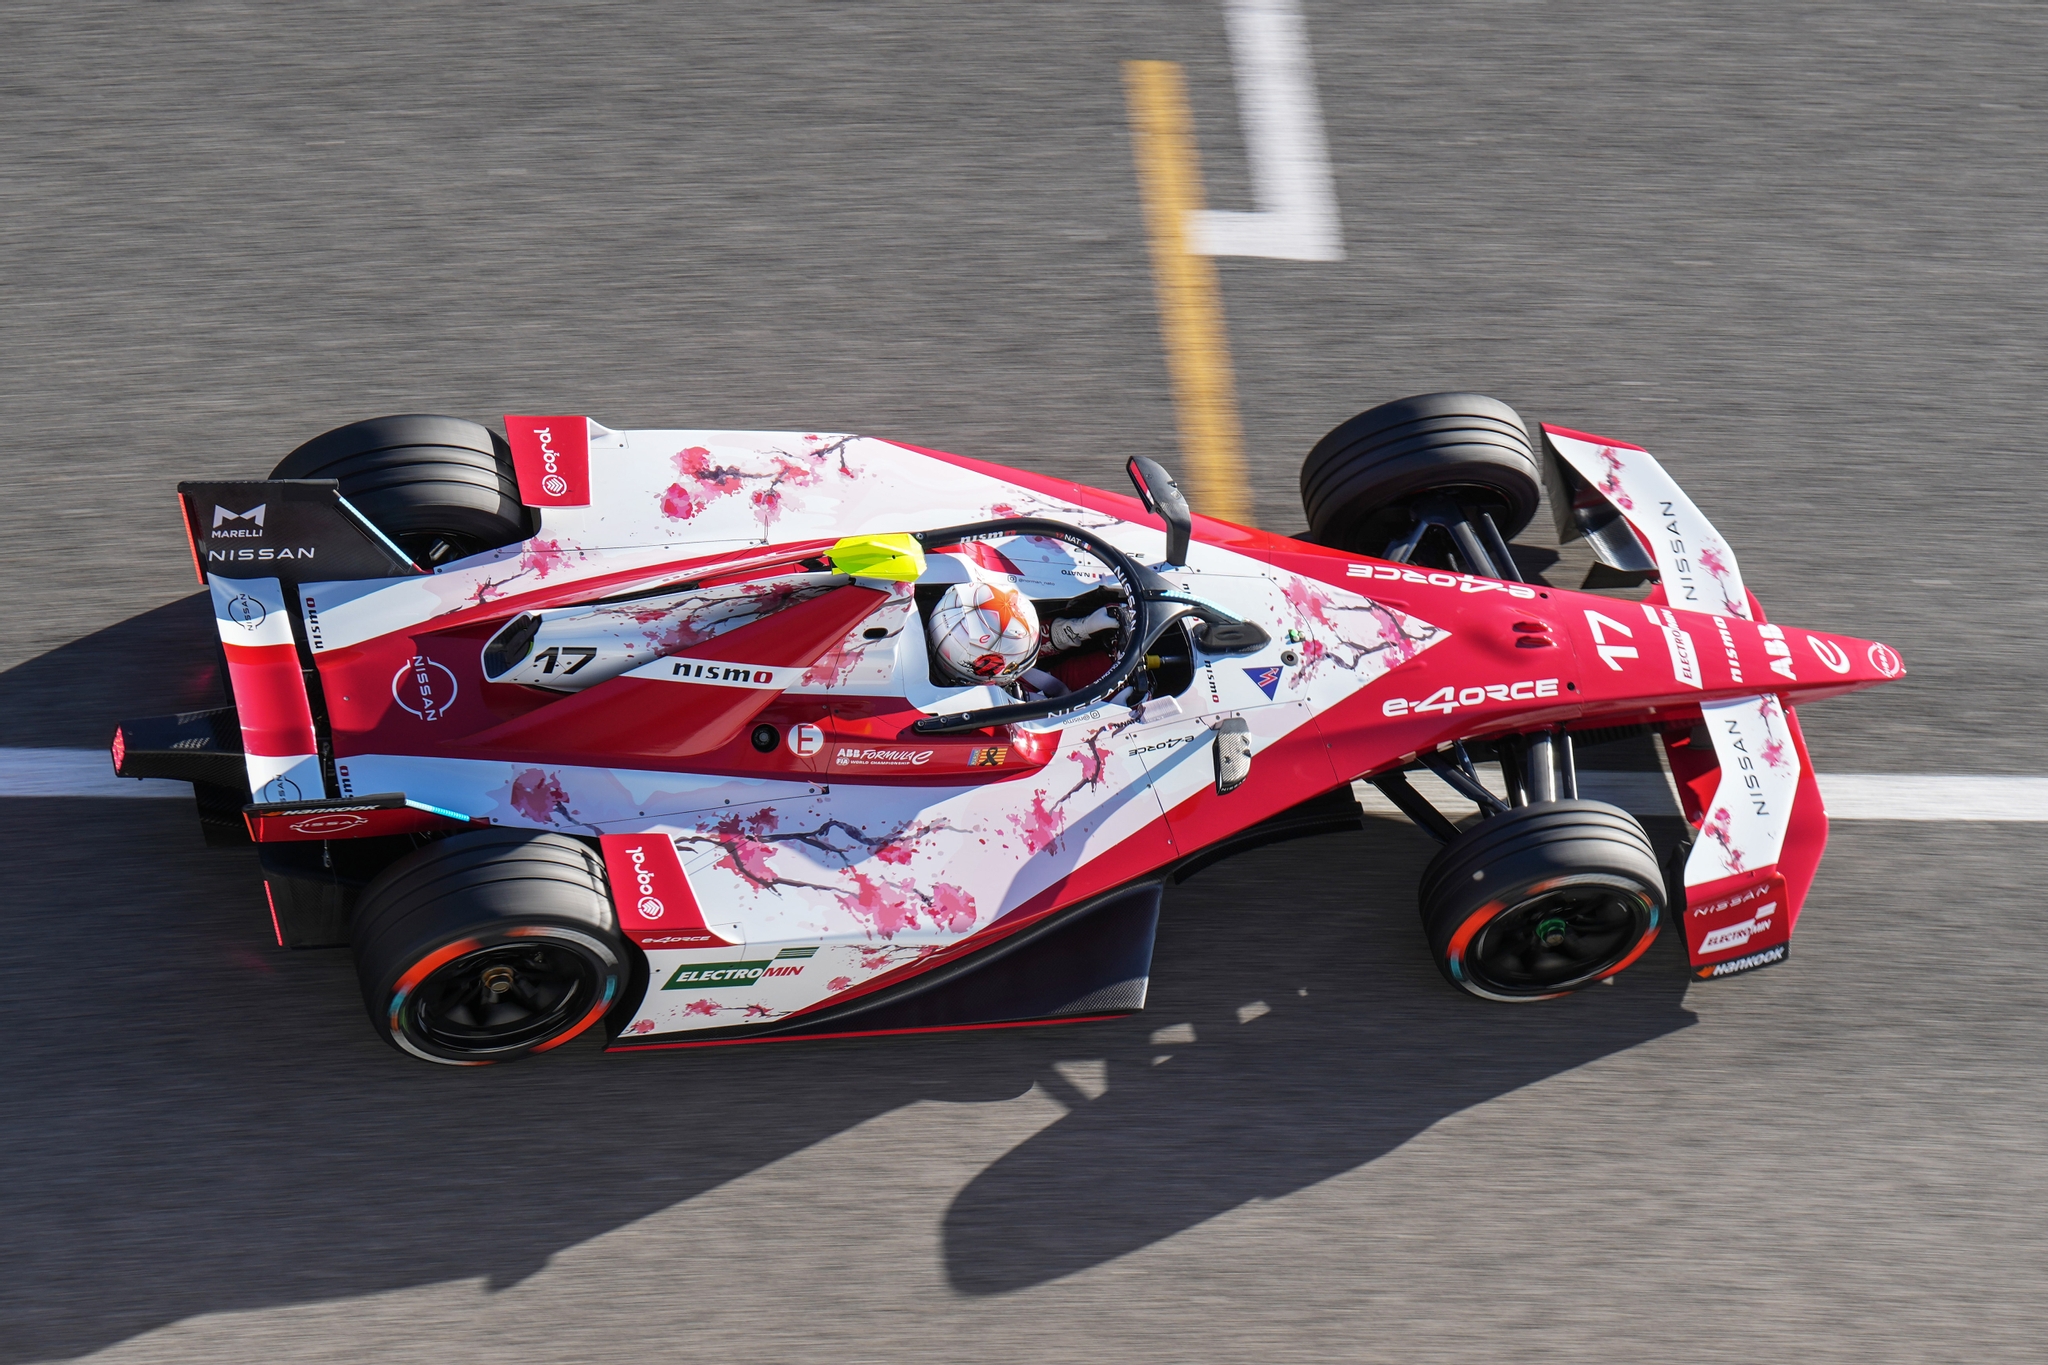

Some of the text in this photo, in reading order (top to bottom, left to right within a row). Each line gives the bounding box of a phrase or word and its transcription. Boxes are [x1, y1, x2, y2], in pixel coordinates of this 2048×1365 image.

[211, 529, 263, 538] MARELLI
[1064, 533, 1082, 545] NAT
[208, 547, 315, 562] NISSAN
[1659, 501, 1698, 601] NISSAN
[240, 593, 254, 631] NISSAN
[1113, 565, 1137, 632] NISSAN
[305, 597, 324, 649] nismo
[1583, 610, 1639, 671] 17
[1713, 616, 1743, 683] nismo
[1757, 623, 1797, 681] ABB
[534, 647, 597, 675] 17
[672, 662, 773, 684] nismo
[412, 655, 438, 721] NISSAN
[1204, 660, 1219, 703] nismo
[836, 748, 861, 758] ABB
[836, 757, 850, 766] FIA
[1725, 719, 1770, 816] NISSAN
[276, 774, 287, 802] SSAN
[339, 765, 354, 798] smo
[289, 818, 369, 831] NISSAN
[1694, 884, 1770, 918] NISSAN
[1707, 919, 1771, 946] ELECTROMIN
[676, 965, 805, 982] ELECTROMIN
